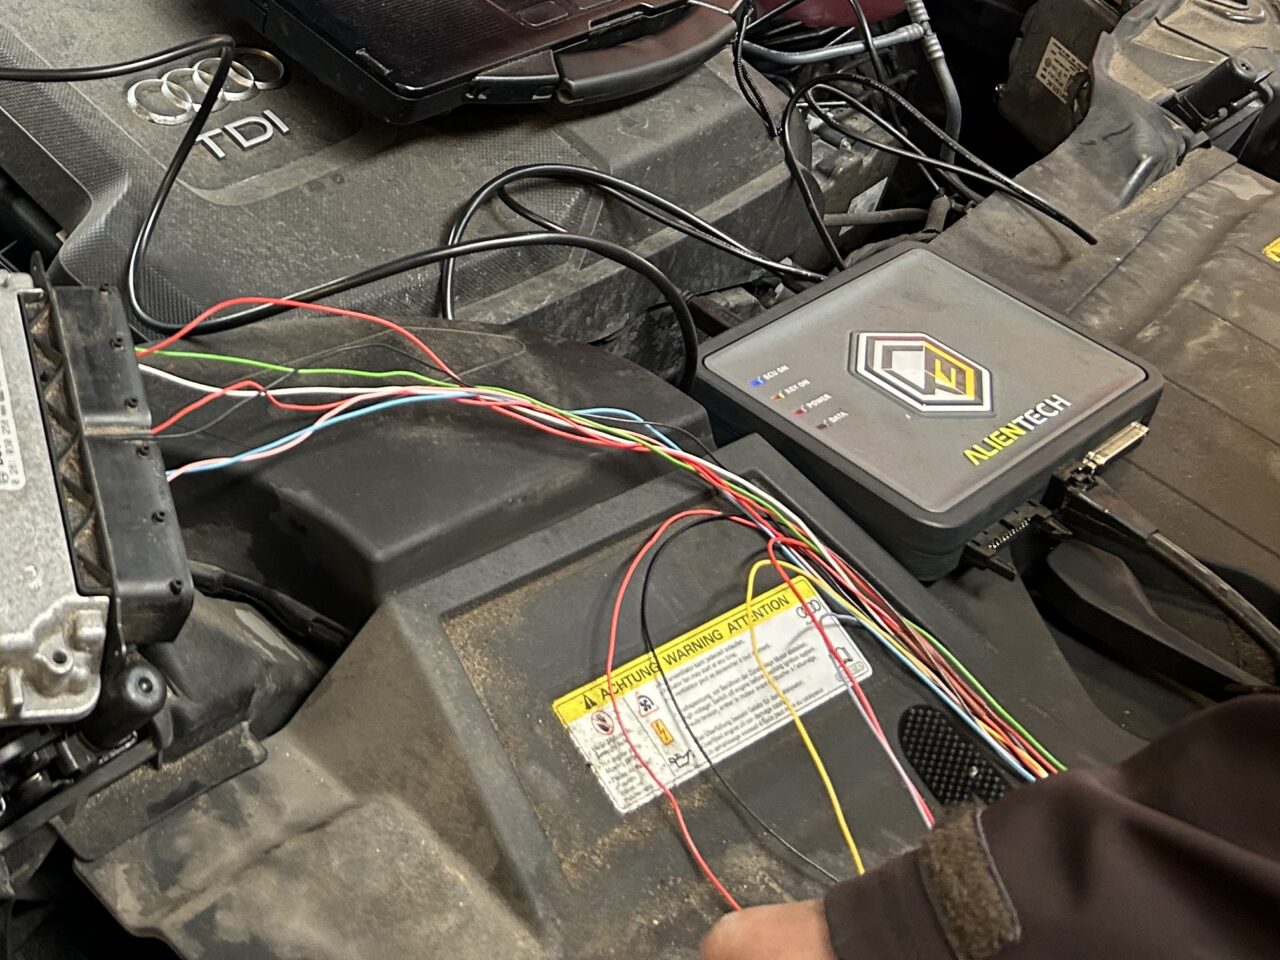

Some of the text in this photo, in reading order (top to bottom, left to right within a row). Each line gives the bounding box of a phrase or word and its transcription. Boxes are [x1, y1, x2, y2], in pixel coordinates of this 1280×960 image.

[196, 109, 289, 160] TDI
[763, 364, 790, 380] ECU ON
[784, 378, 811, 394] KEY ON
[806, 393, 832, 408] POWER
[828, 411, 849, 423] DATA
[963, 394, 1072, 466] ALIENTECH
[600, 661, 660, 700] ACHTUNG
[662, 629, 724, 667] WARNING
